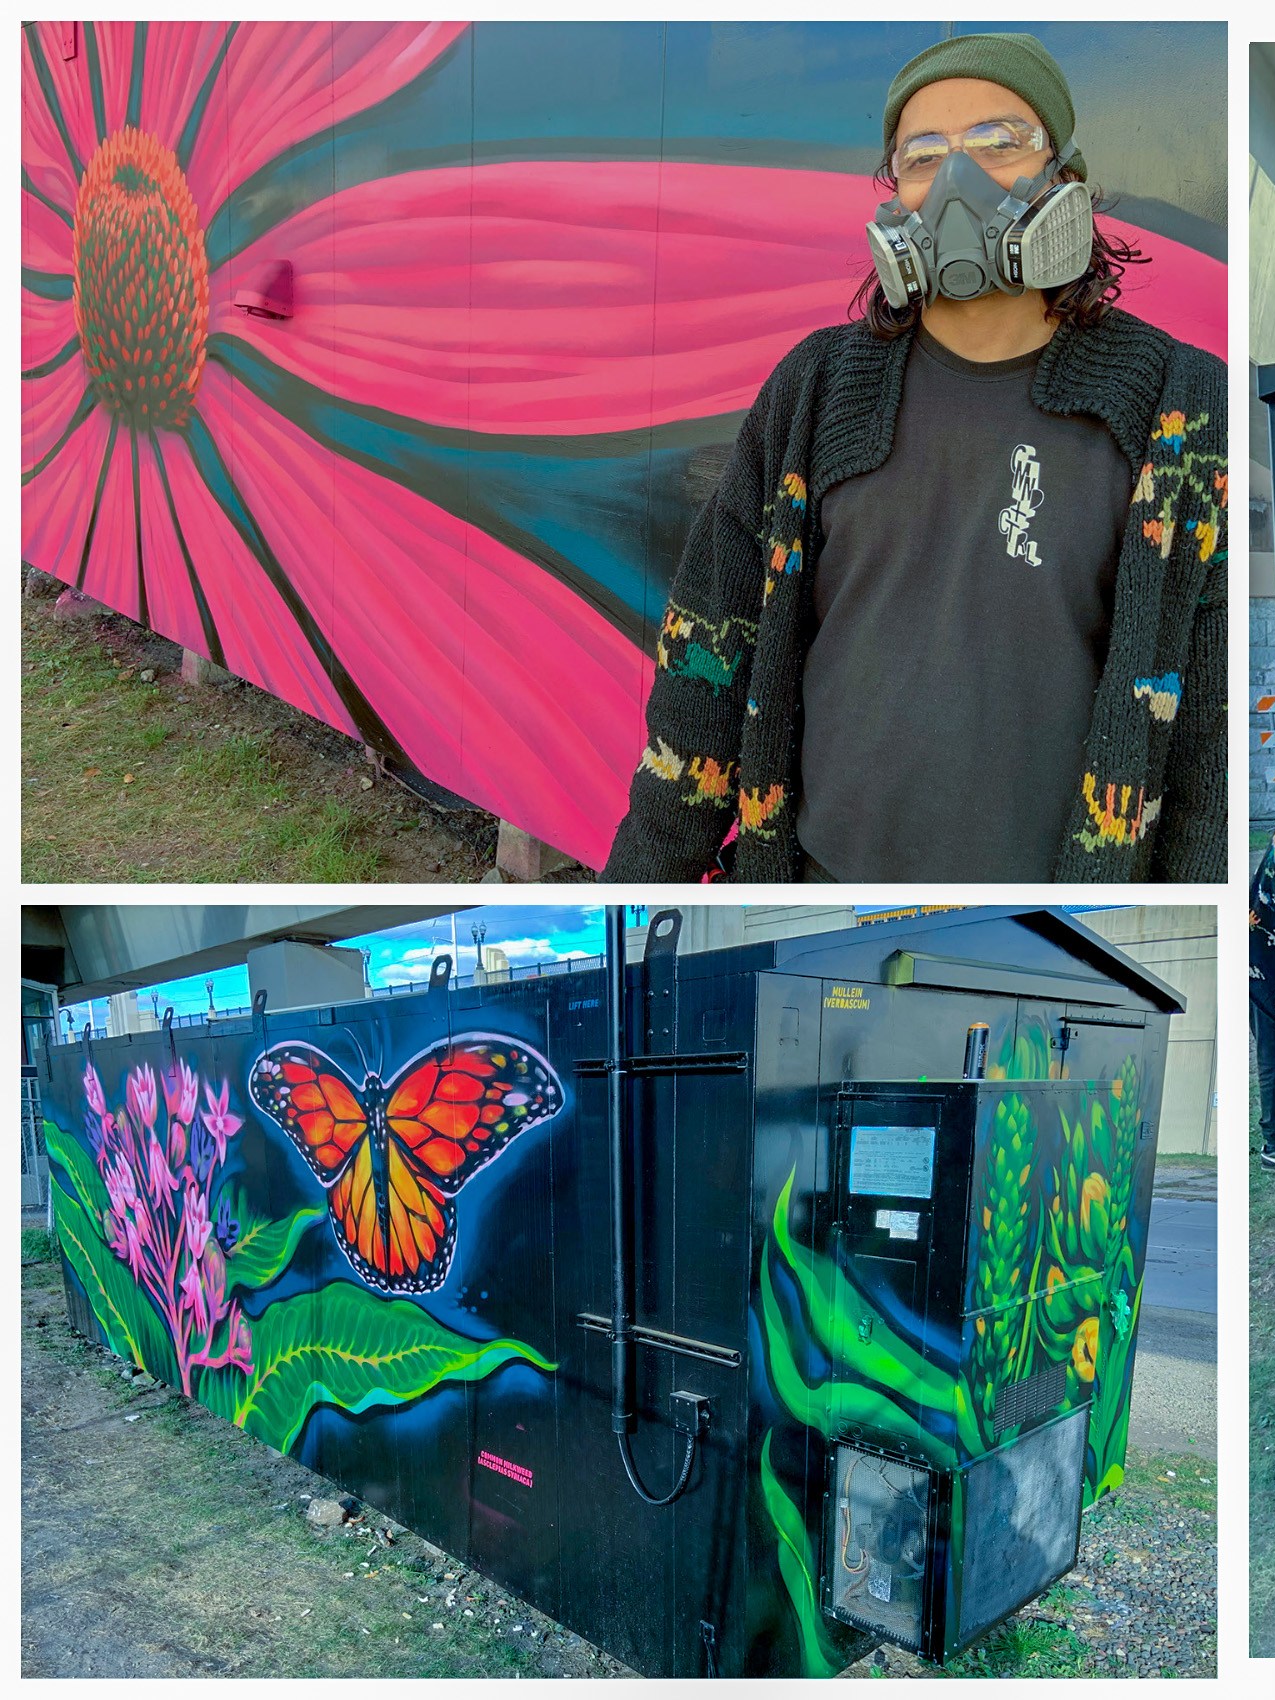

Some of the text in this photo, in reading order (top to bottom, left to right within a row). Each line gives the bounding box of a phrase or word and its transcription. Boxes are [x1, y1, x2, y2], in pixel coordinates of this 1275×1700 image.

[948, 271, 977, 286] 3M
[831, 986, 863, 998] MULLEIN
[568, 998, 599, 1011] LIFT HERE
[823, 997, 871, 1010] (VERBASCUM)
